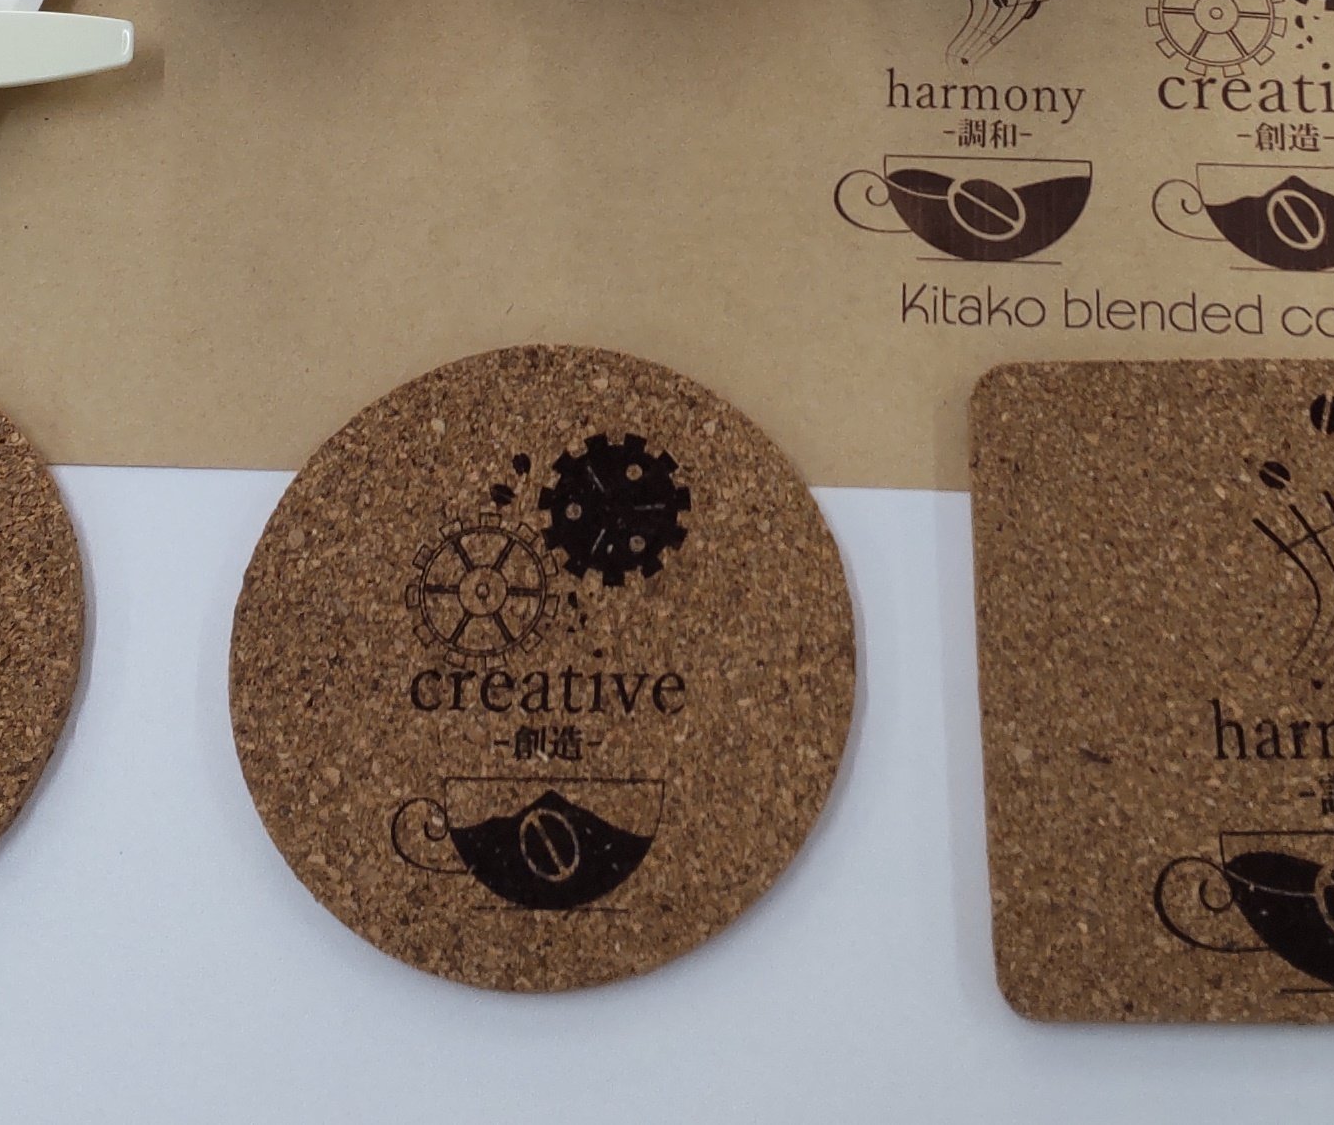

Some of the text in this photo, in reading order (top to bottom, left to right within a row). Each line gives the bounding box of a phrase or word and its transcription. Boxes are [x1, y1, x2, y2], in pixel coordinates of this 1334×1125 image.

[886, 68, 1086, 123] harmony
[901, 283, 1047, 329] Kitako
[1063, 288, 1264, 335] blended
[408, 649, 687, 715] creative
